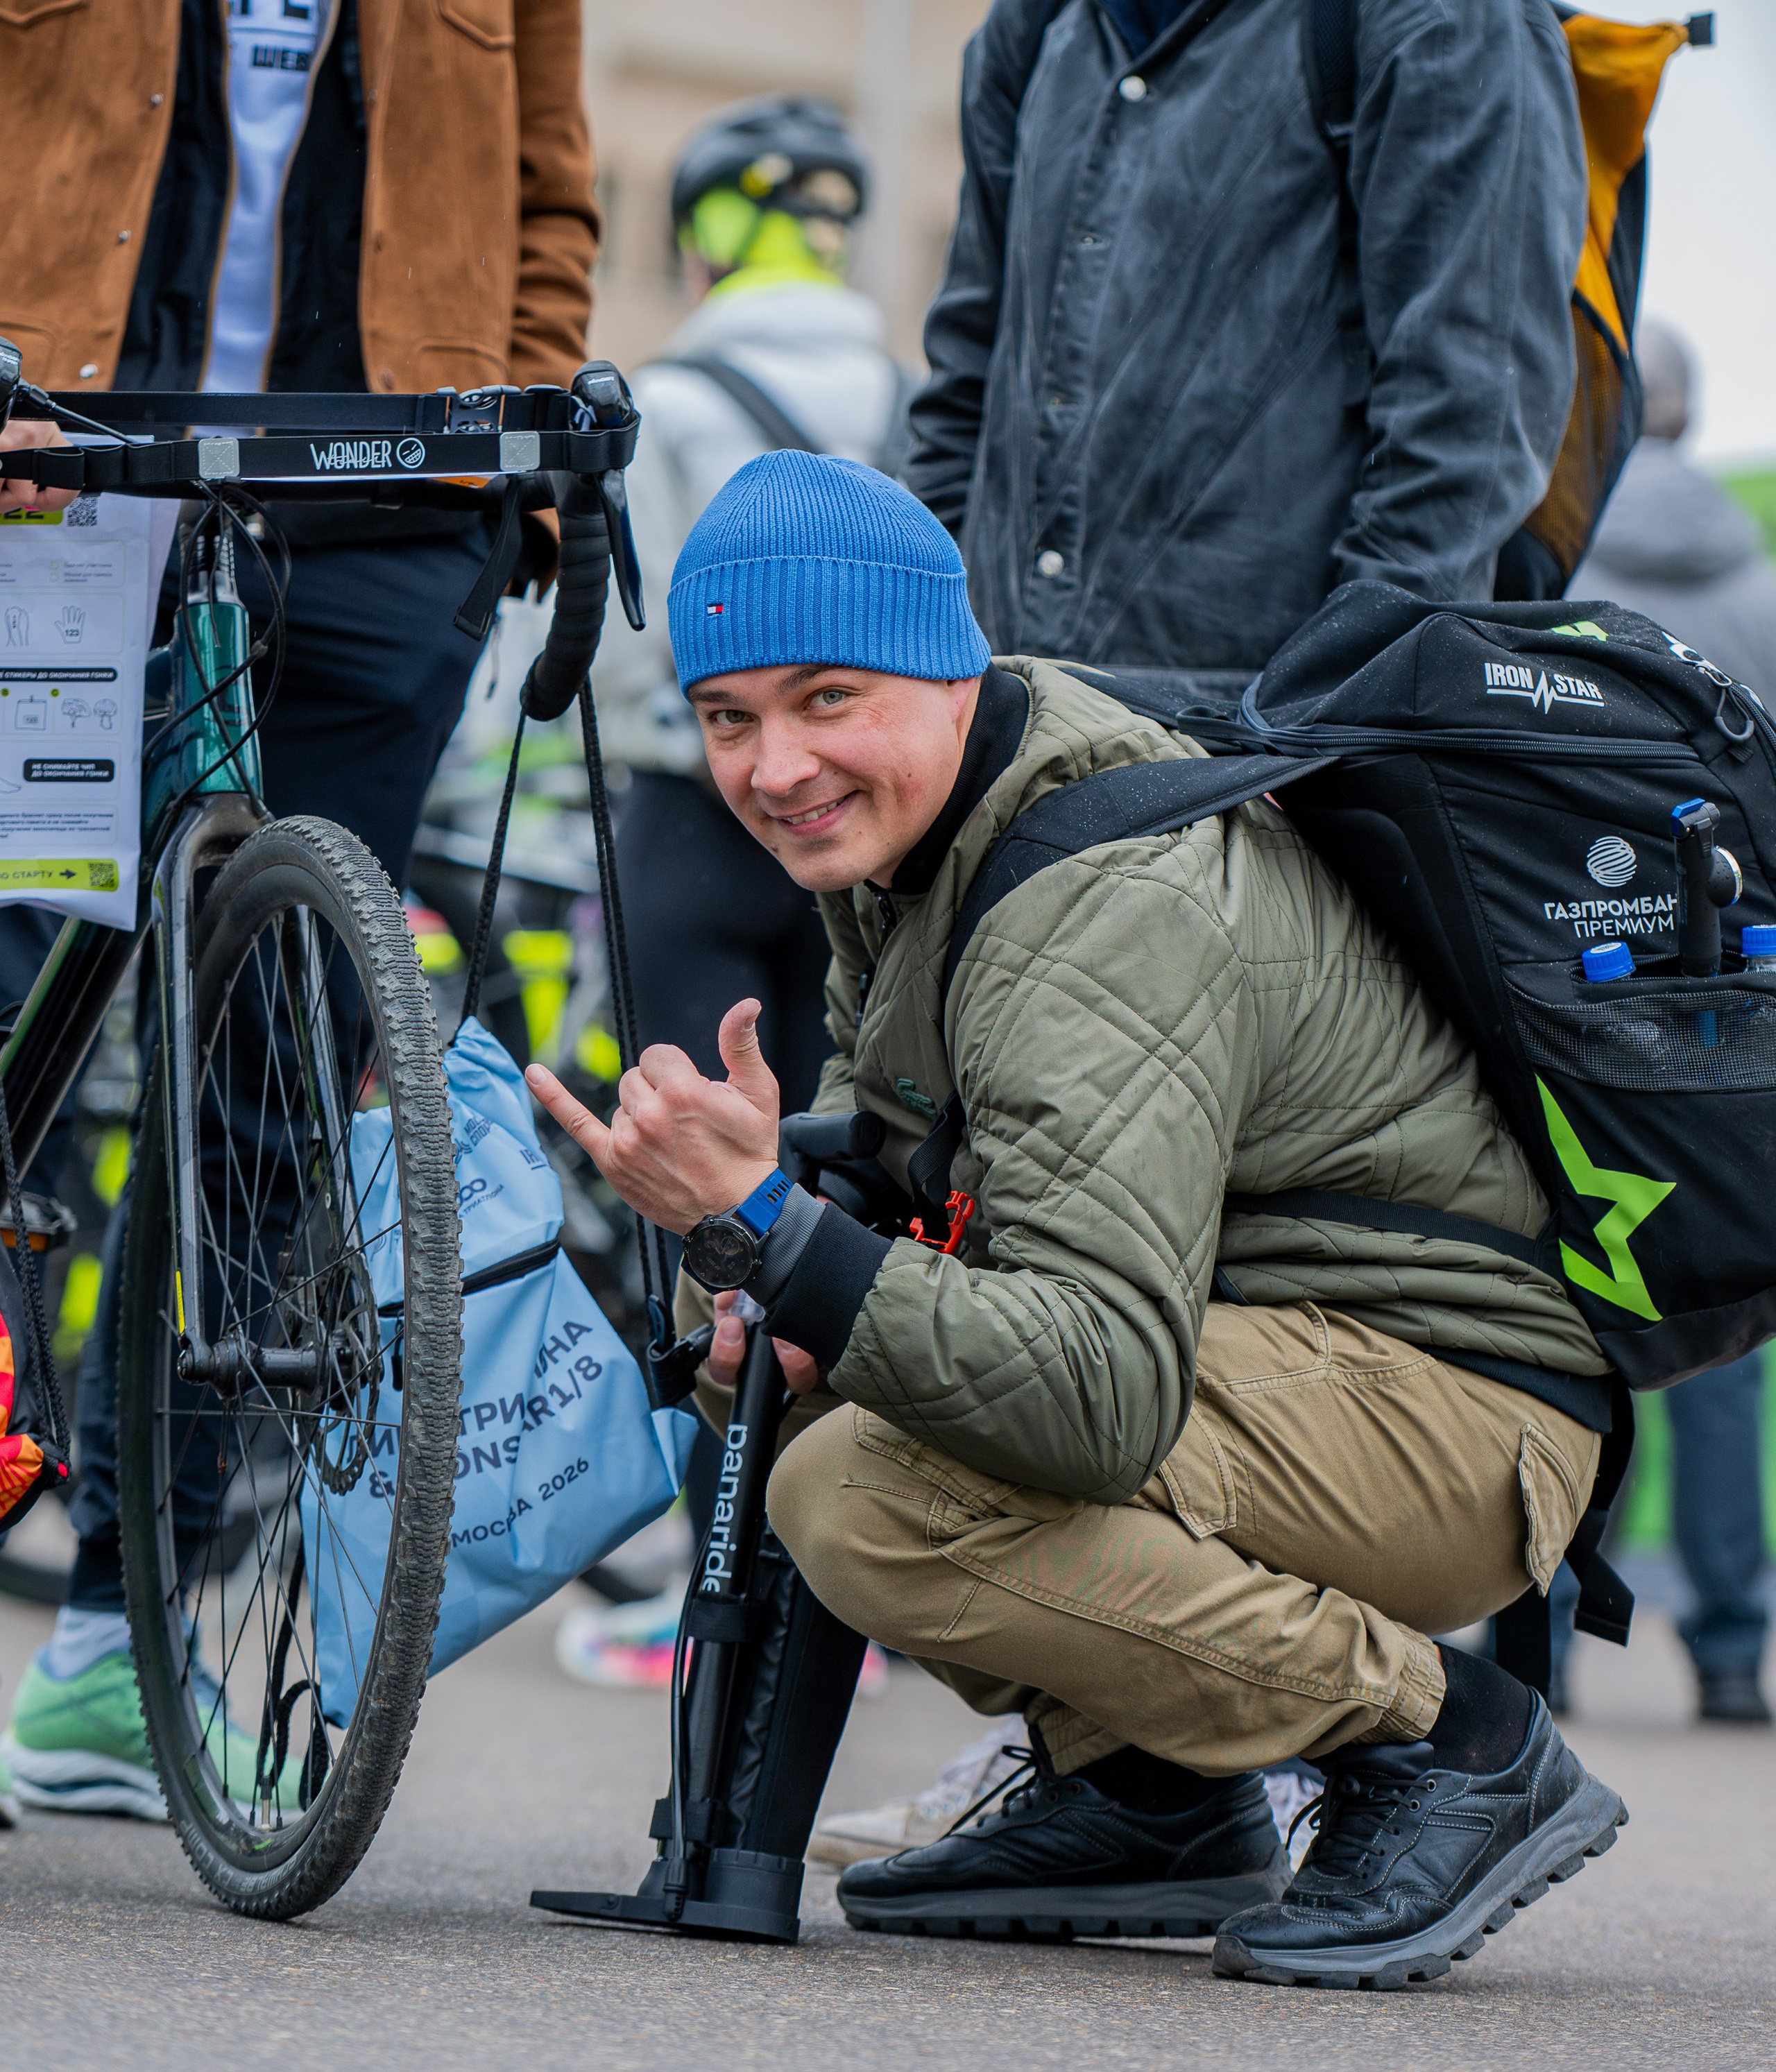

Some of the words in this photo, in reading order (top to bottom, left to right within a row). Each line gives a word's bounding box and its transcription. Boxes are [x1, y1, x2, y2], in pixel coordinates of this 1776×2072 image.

[309, 440, 392, 470] WONDER
[1484, 662, 1535, 690] IRON
[1553, 673, 1603, 700] STAR
[12, 870, 53, 879] СТАРТУ
[1544, 893, 1677, 921] ГАЗПРОМБАН
[1574, 914, 1674, 939] ПРЕМИУМ
[369, 1471, 395, 1498] &
[538, 1457, 589, 1501] 2026
